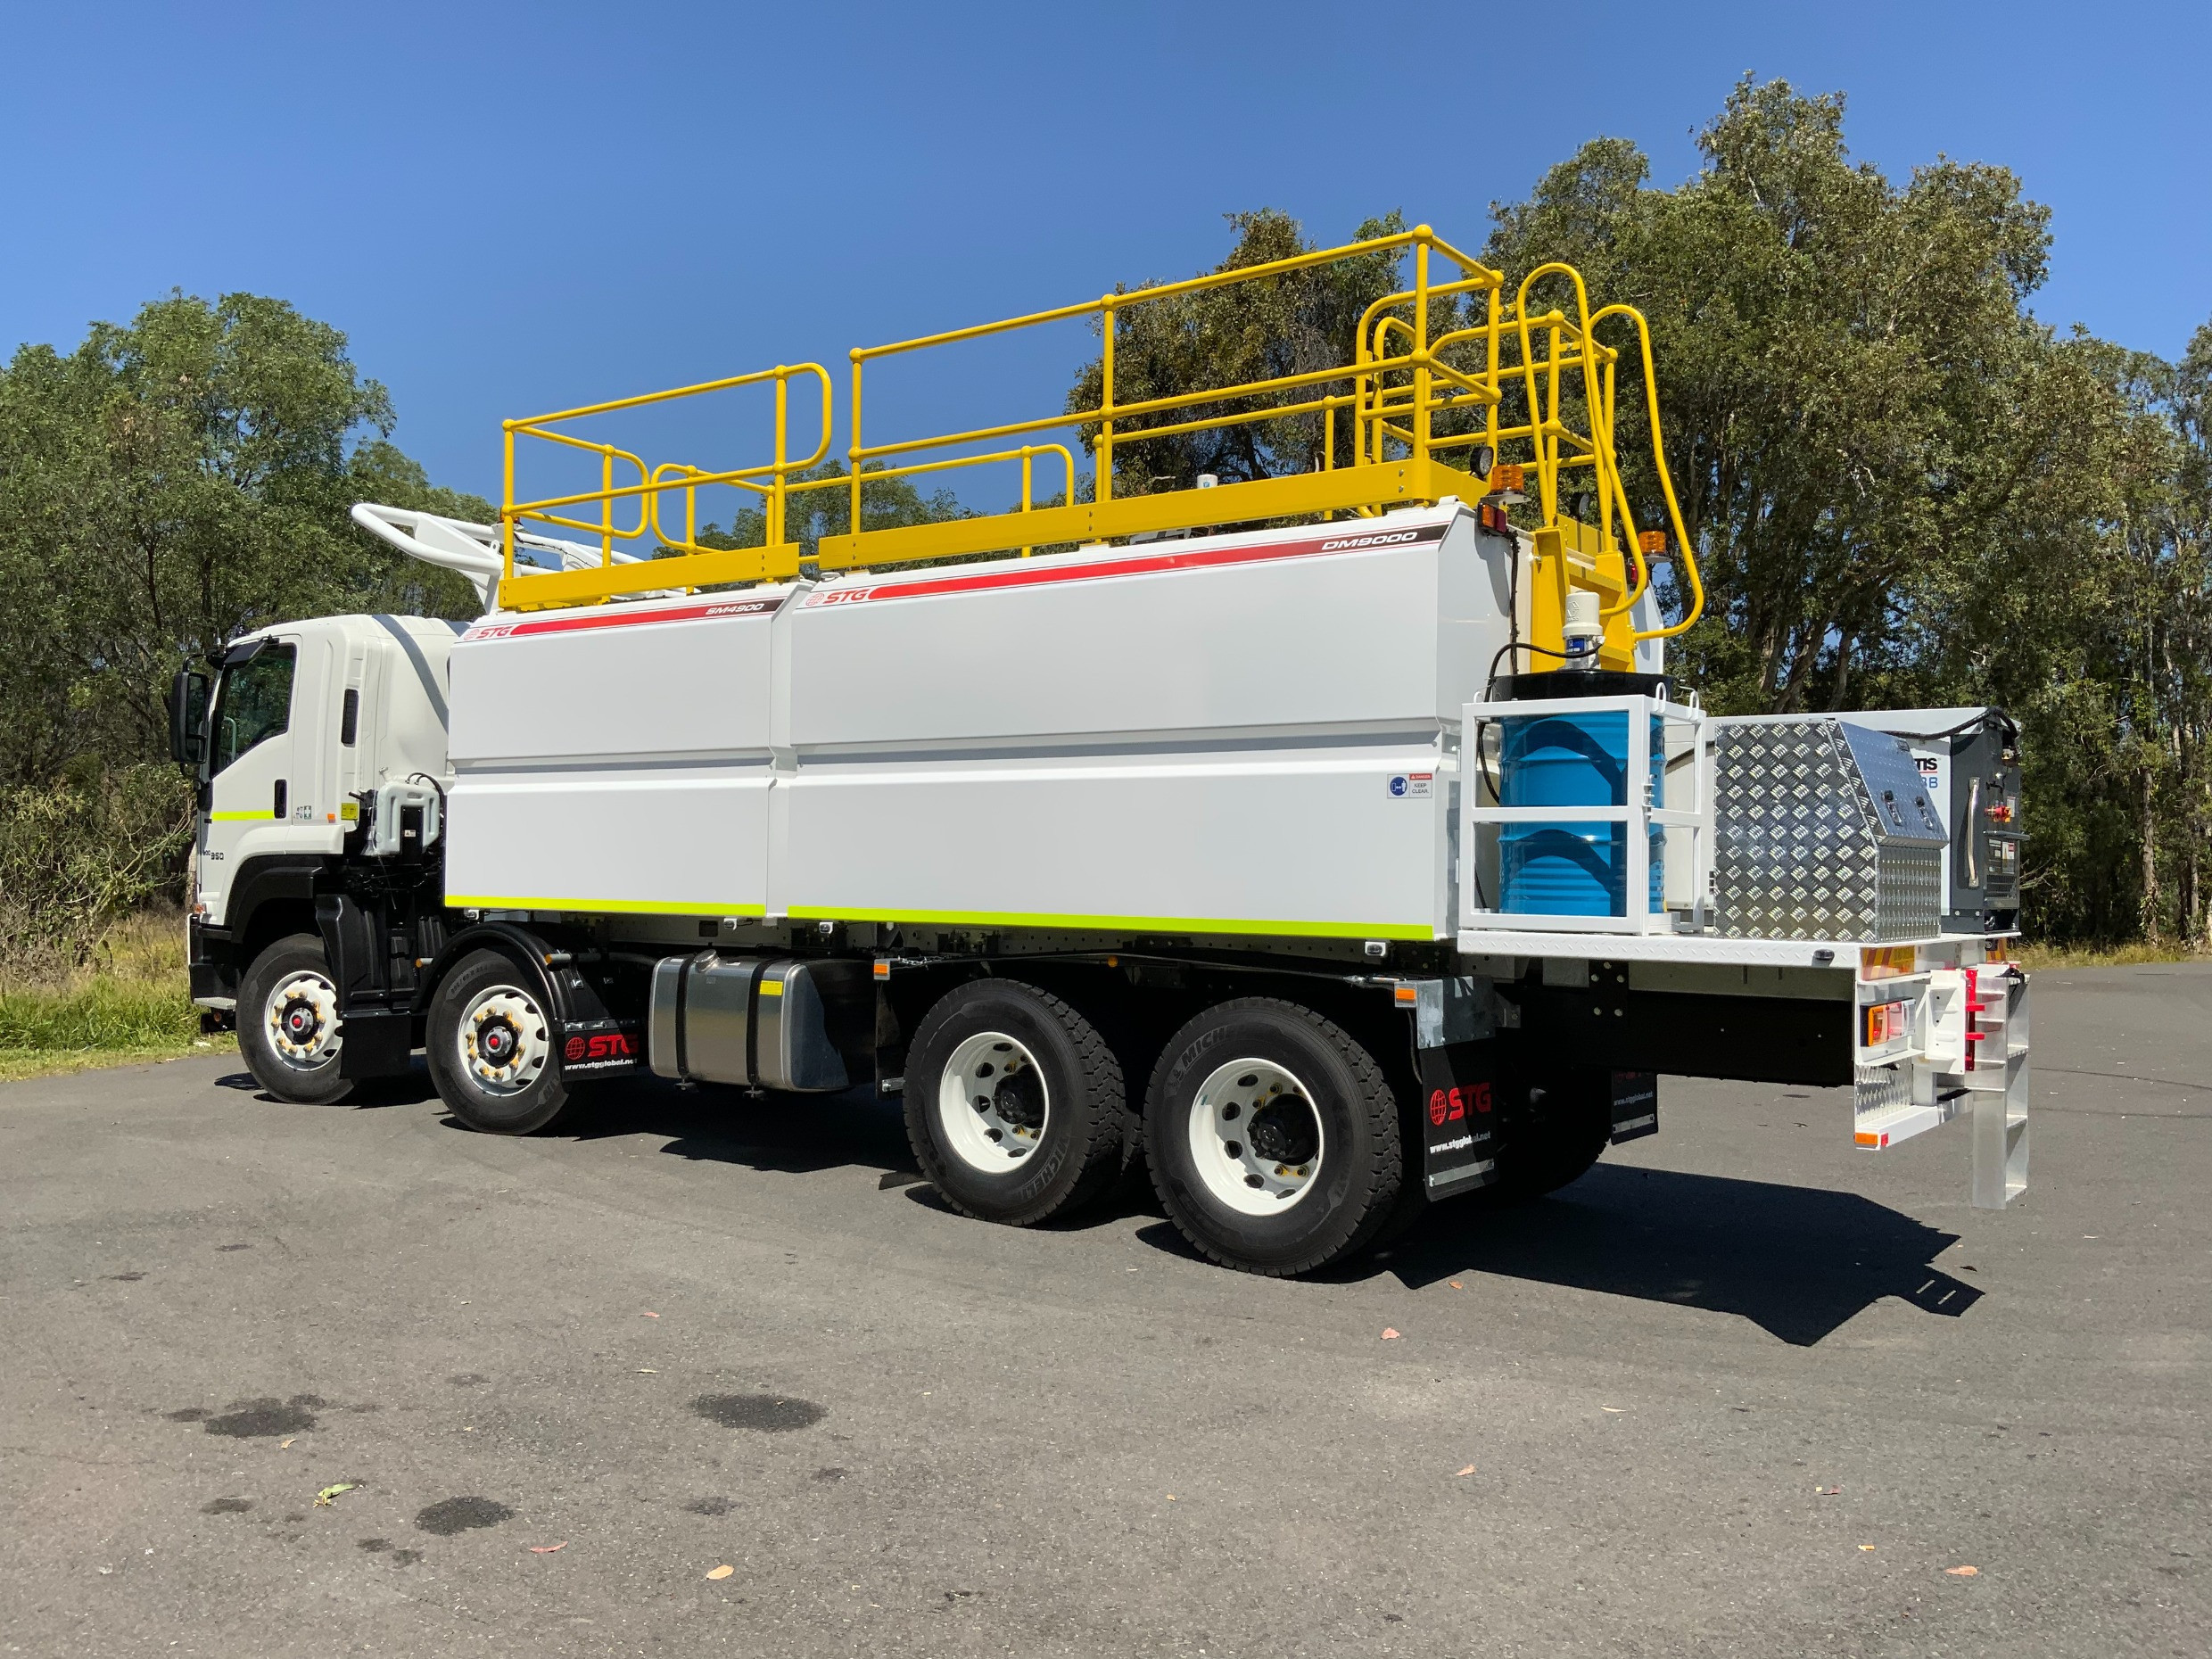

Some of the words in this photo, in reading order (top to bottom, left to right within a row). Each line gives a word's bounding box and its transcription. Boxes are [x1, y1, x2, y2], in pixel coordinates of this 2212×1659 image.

[1321, 532, 1418, 550] DM9000
[823, 588, 871, 605] STG
[705, 603, 765, 615] SM4900
[475, 625, 514, 640] STG
[588, 1035, 639, 1057] STG
[1448, 1082, 1493, 1121] STG
